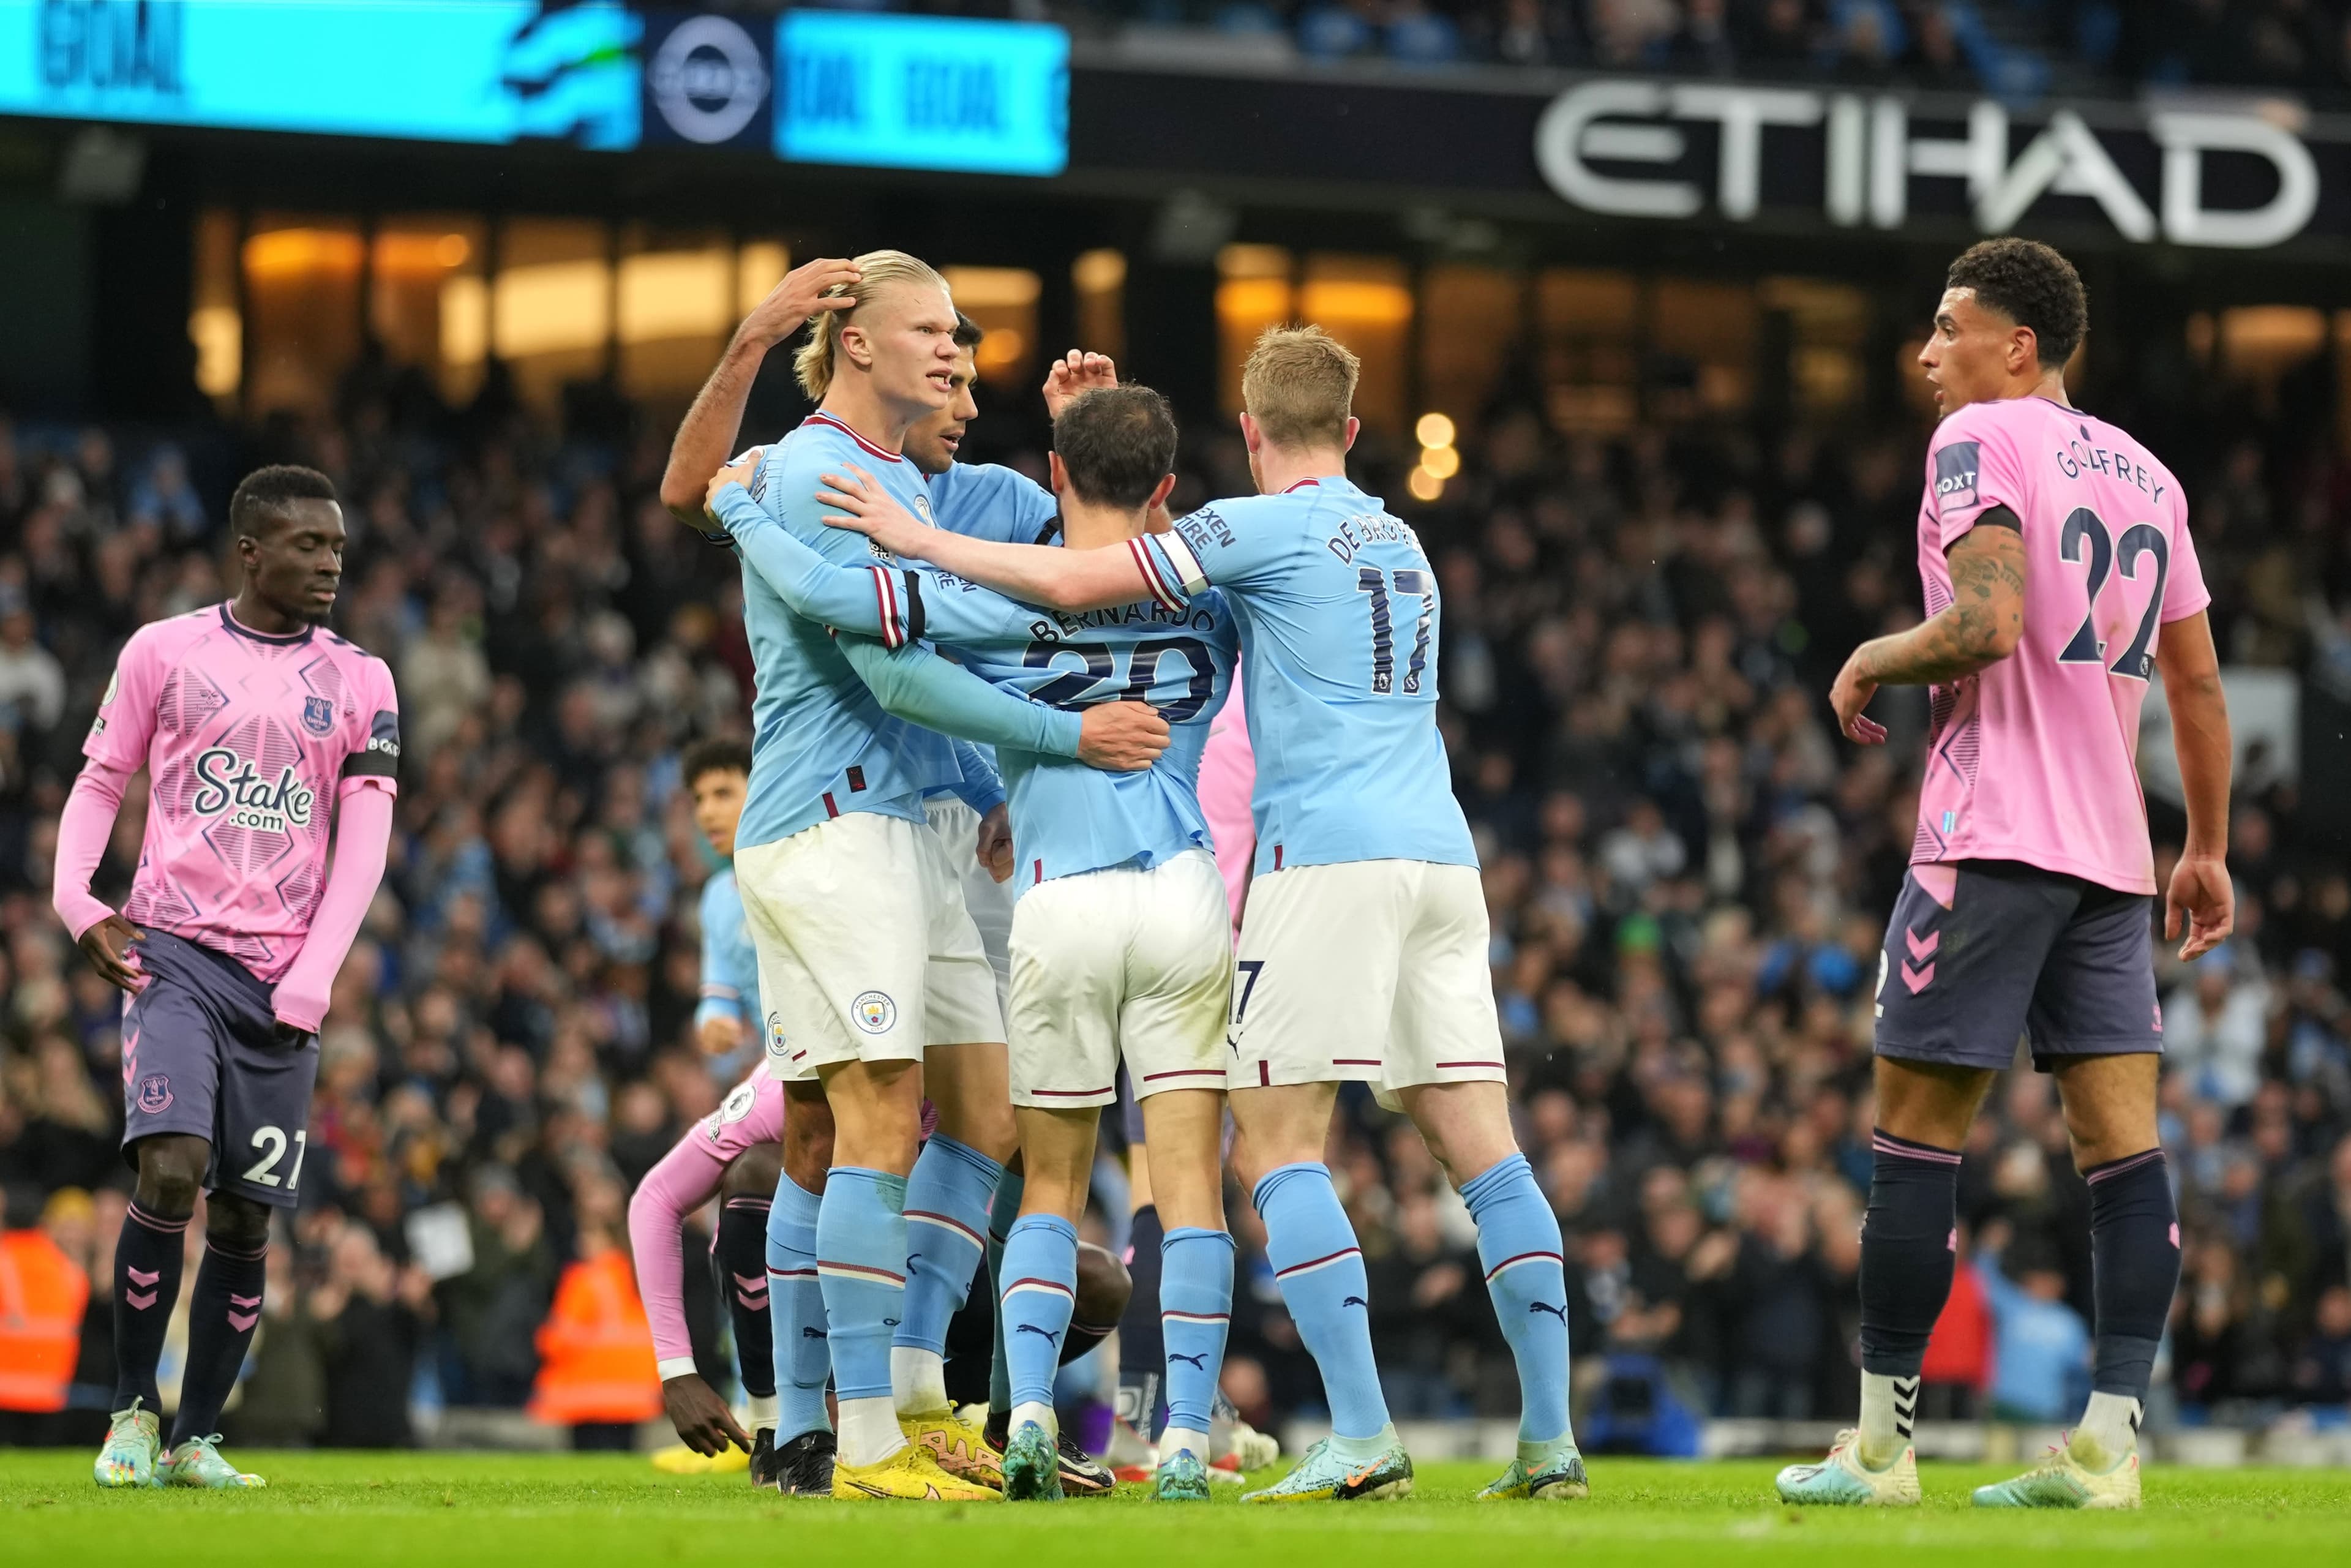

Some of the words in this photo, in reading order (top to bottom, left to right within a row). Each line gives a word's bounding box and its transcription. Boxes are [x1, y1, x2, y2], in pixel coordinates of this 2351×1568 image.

[1534, 78, 2319, 249] ETIHAD
[1937, 471, 1976, 500] BOXT
[1176, 516, 1213, 550] TIRE
[1194, 507, 1237, 549] EXEN
[1327, 521, 1361, 566] DE
[2057, 507, 2170, 683] 22
[1028, 600, 1216, 643] BERNARDO
[1357, 568, 1433, 695] 17
[1022, 637, 1218, 724] 20
[194, 749, 313, 826] Stake
[230, 811, 284, 831] .com
[855, 994, 891, 1010] MANCHESTER
